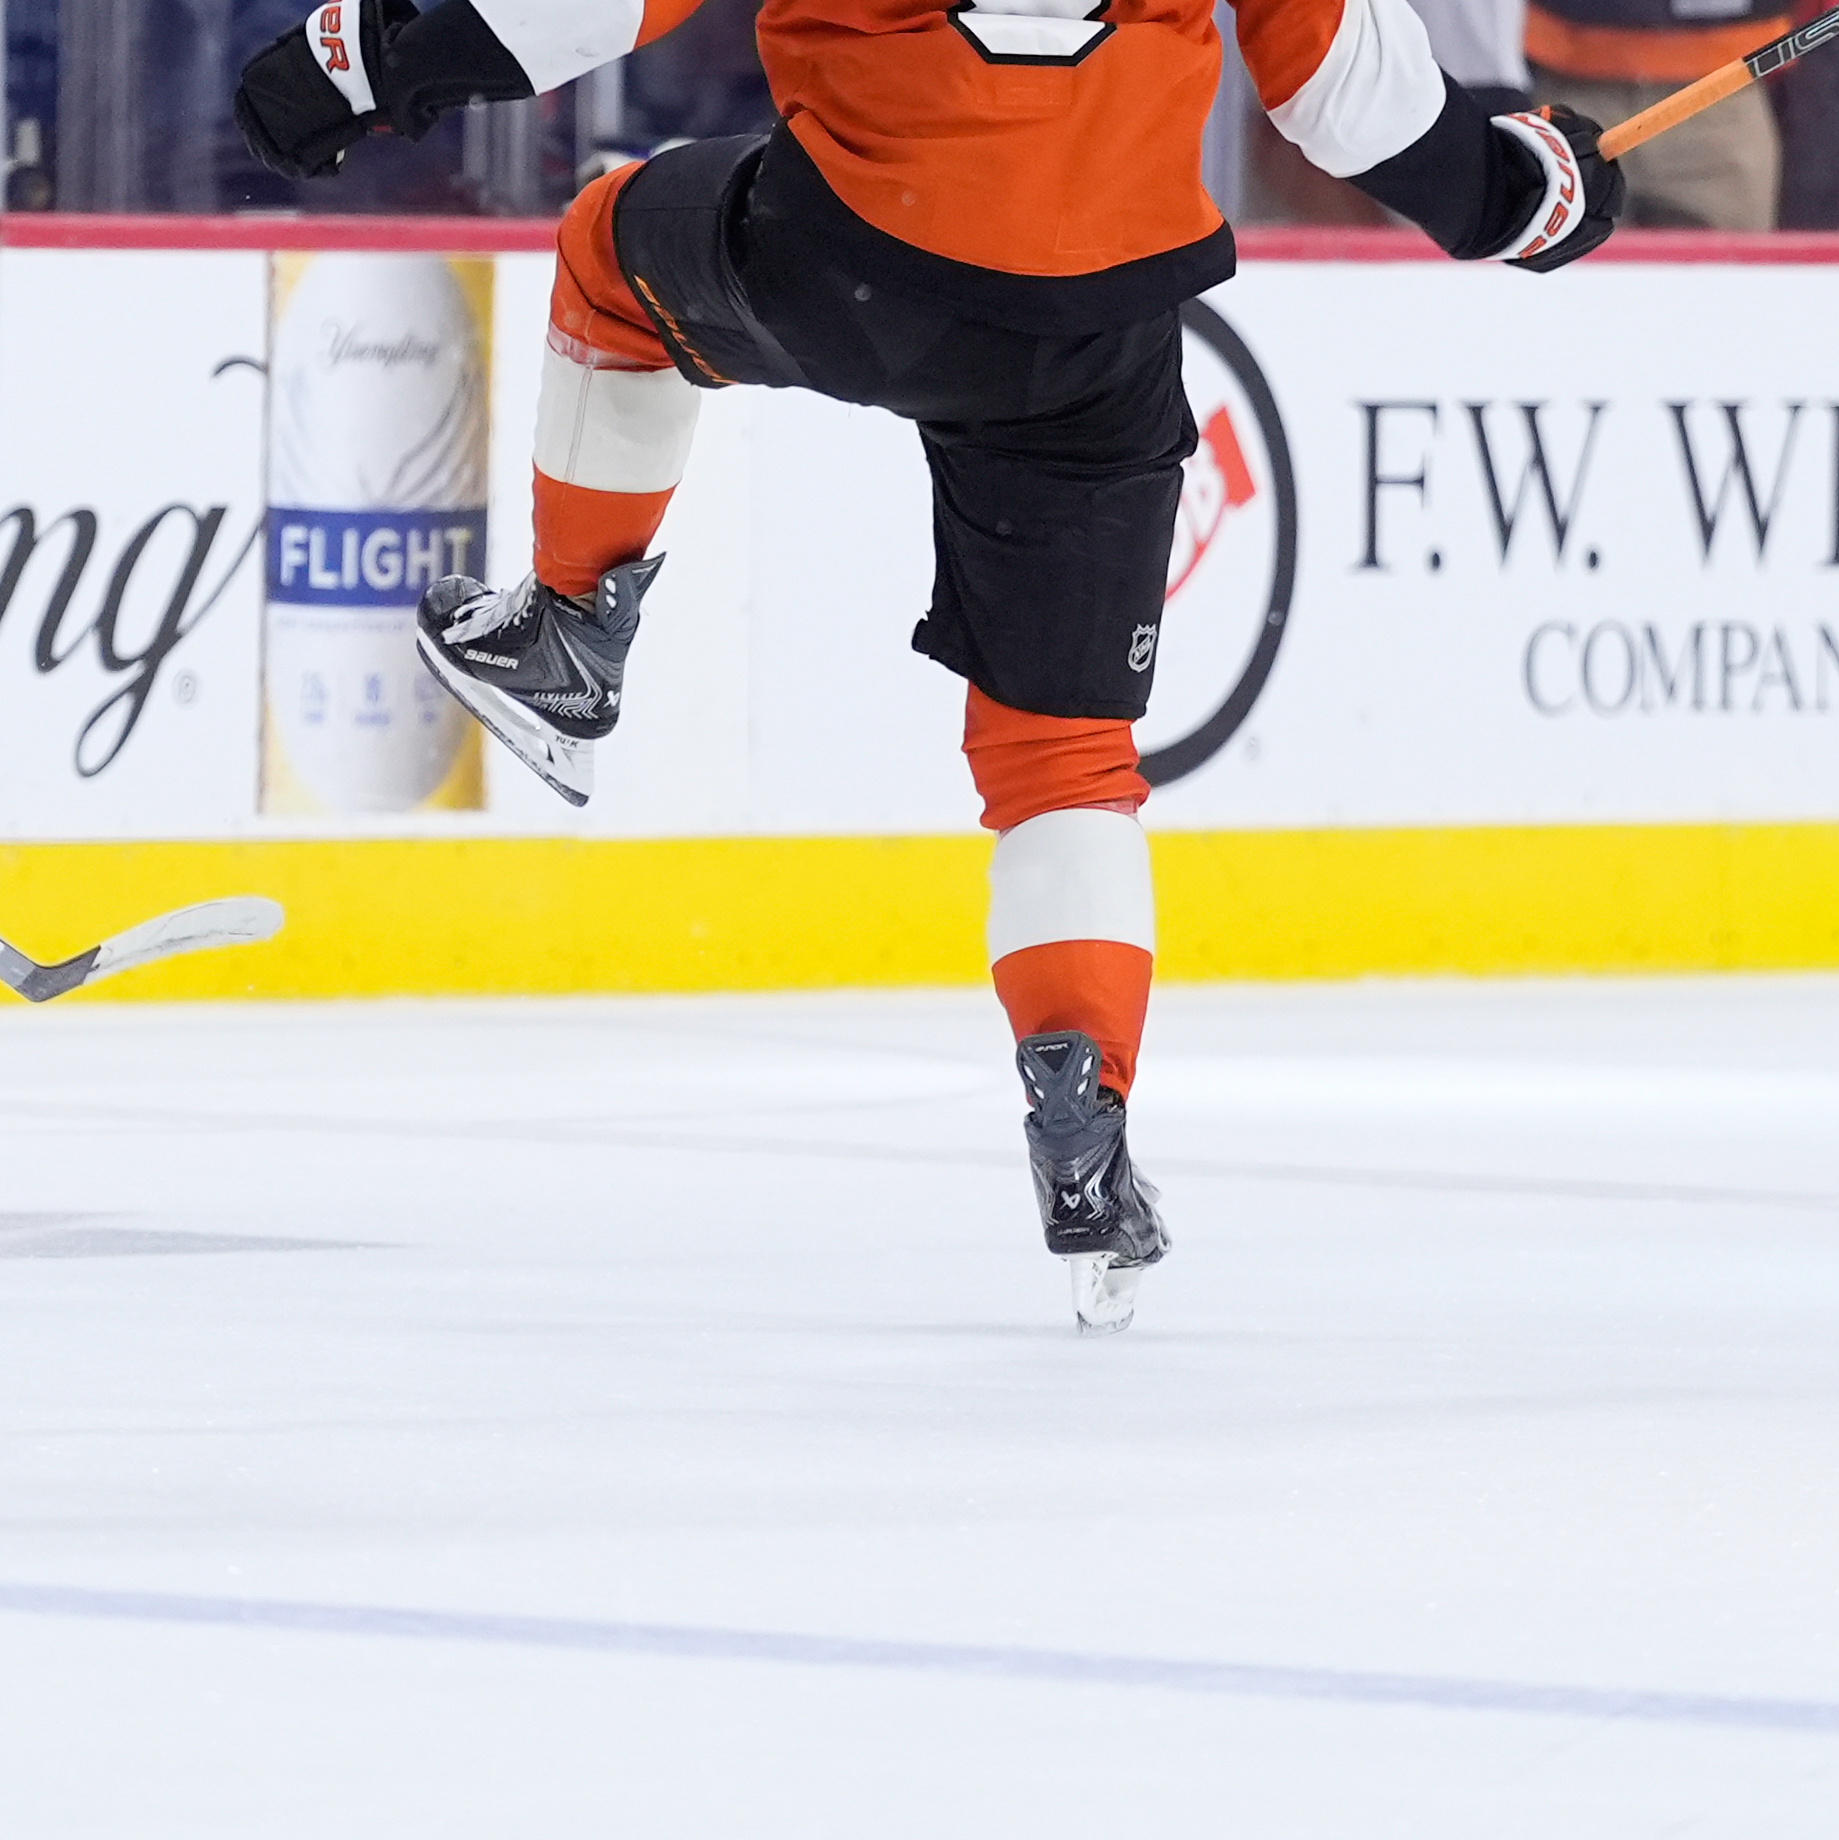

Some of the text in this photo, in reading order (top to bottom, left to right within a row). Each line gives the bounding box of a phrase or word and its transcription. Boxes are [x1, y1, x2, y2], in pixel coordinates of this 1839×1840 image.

[1351, 400, 1612, 573] F.W.
[278, 522, 474, 593] FLIGHT
[464, 648, 520, 670] BAUER
